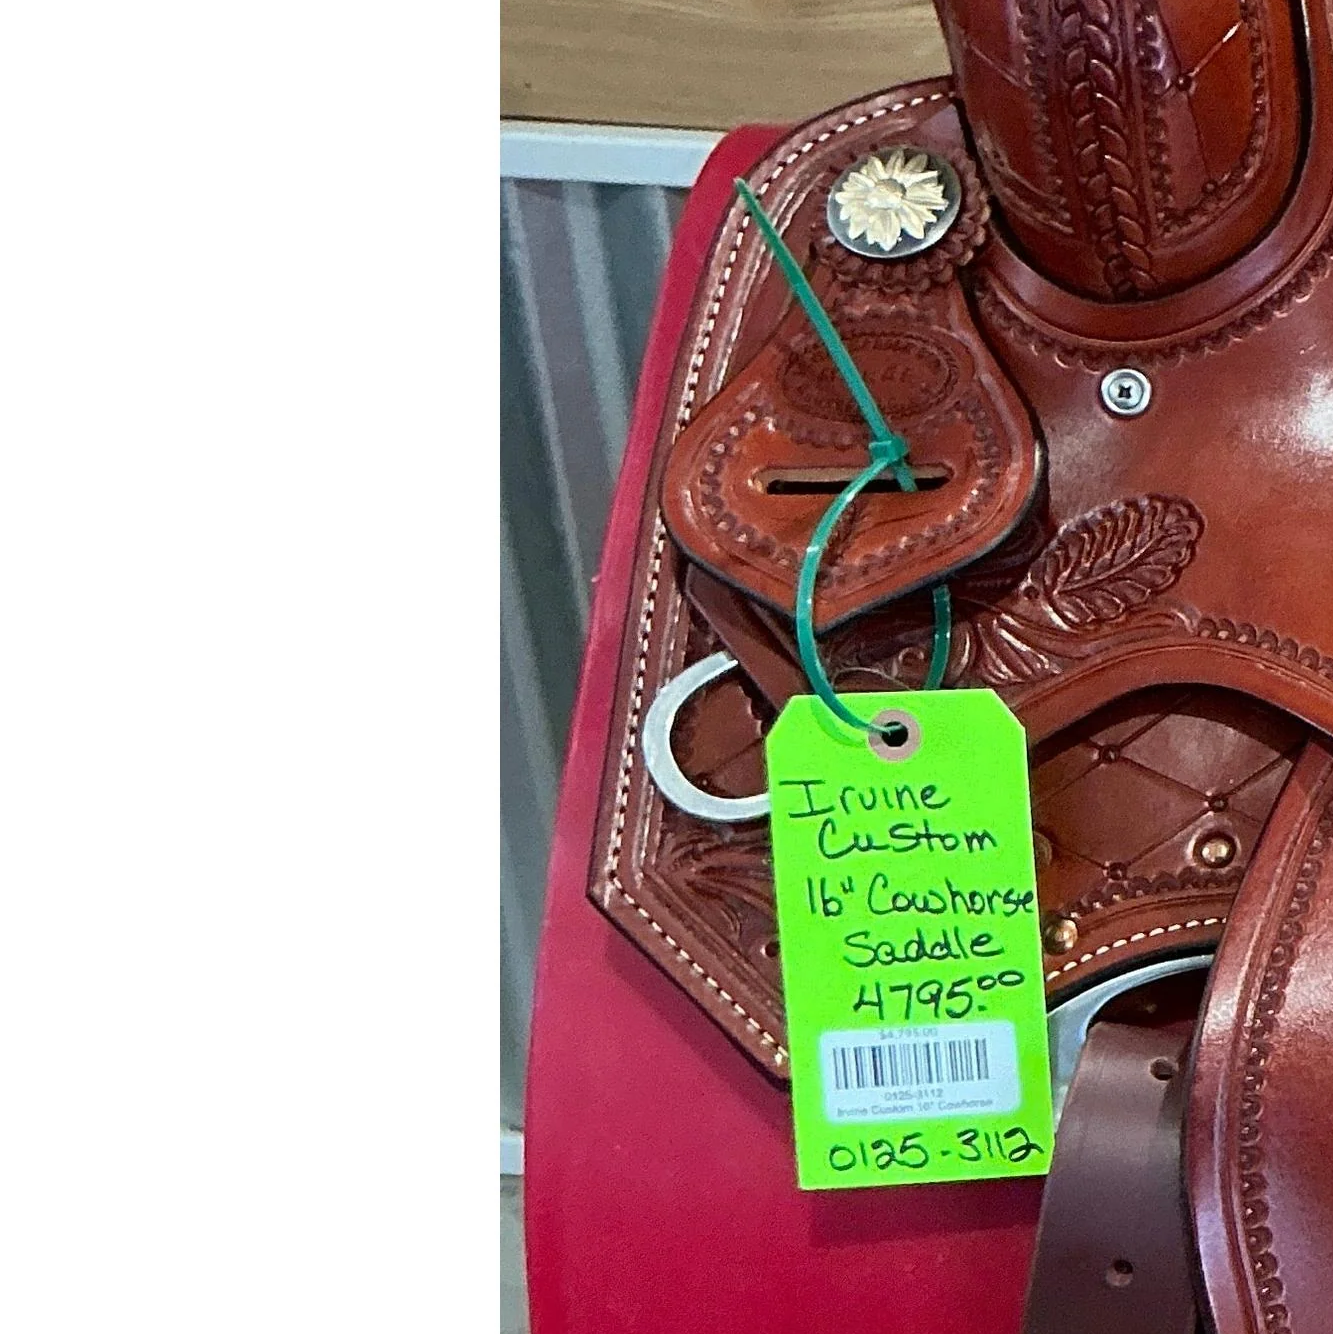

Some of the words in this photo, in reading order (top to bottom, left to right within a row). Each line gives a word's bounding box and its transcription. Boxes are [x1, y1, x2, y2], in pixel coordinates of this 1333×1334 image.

[778, 779, 952, 818] Irvine
[807, 875, 855, 917] 16"
[867, 872, 1034, 917] Cowhorse
[843, 926, 1005, 968] Saddle
[871, 1103, 914, 1114] Custom
[938, 1098, 993, 1110] Cowhorse
[884, 1088, 944, 1101] 0125-3112
